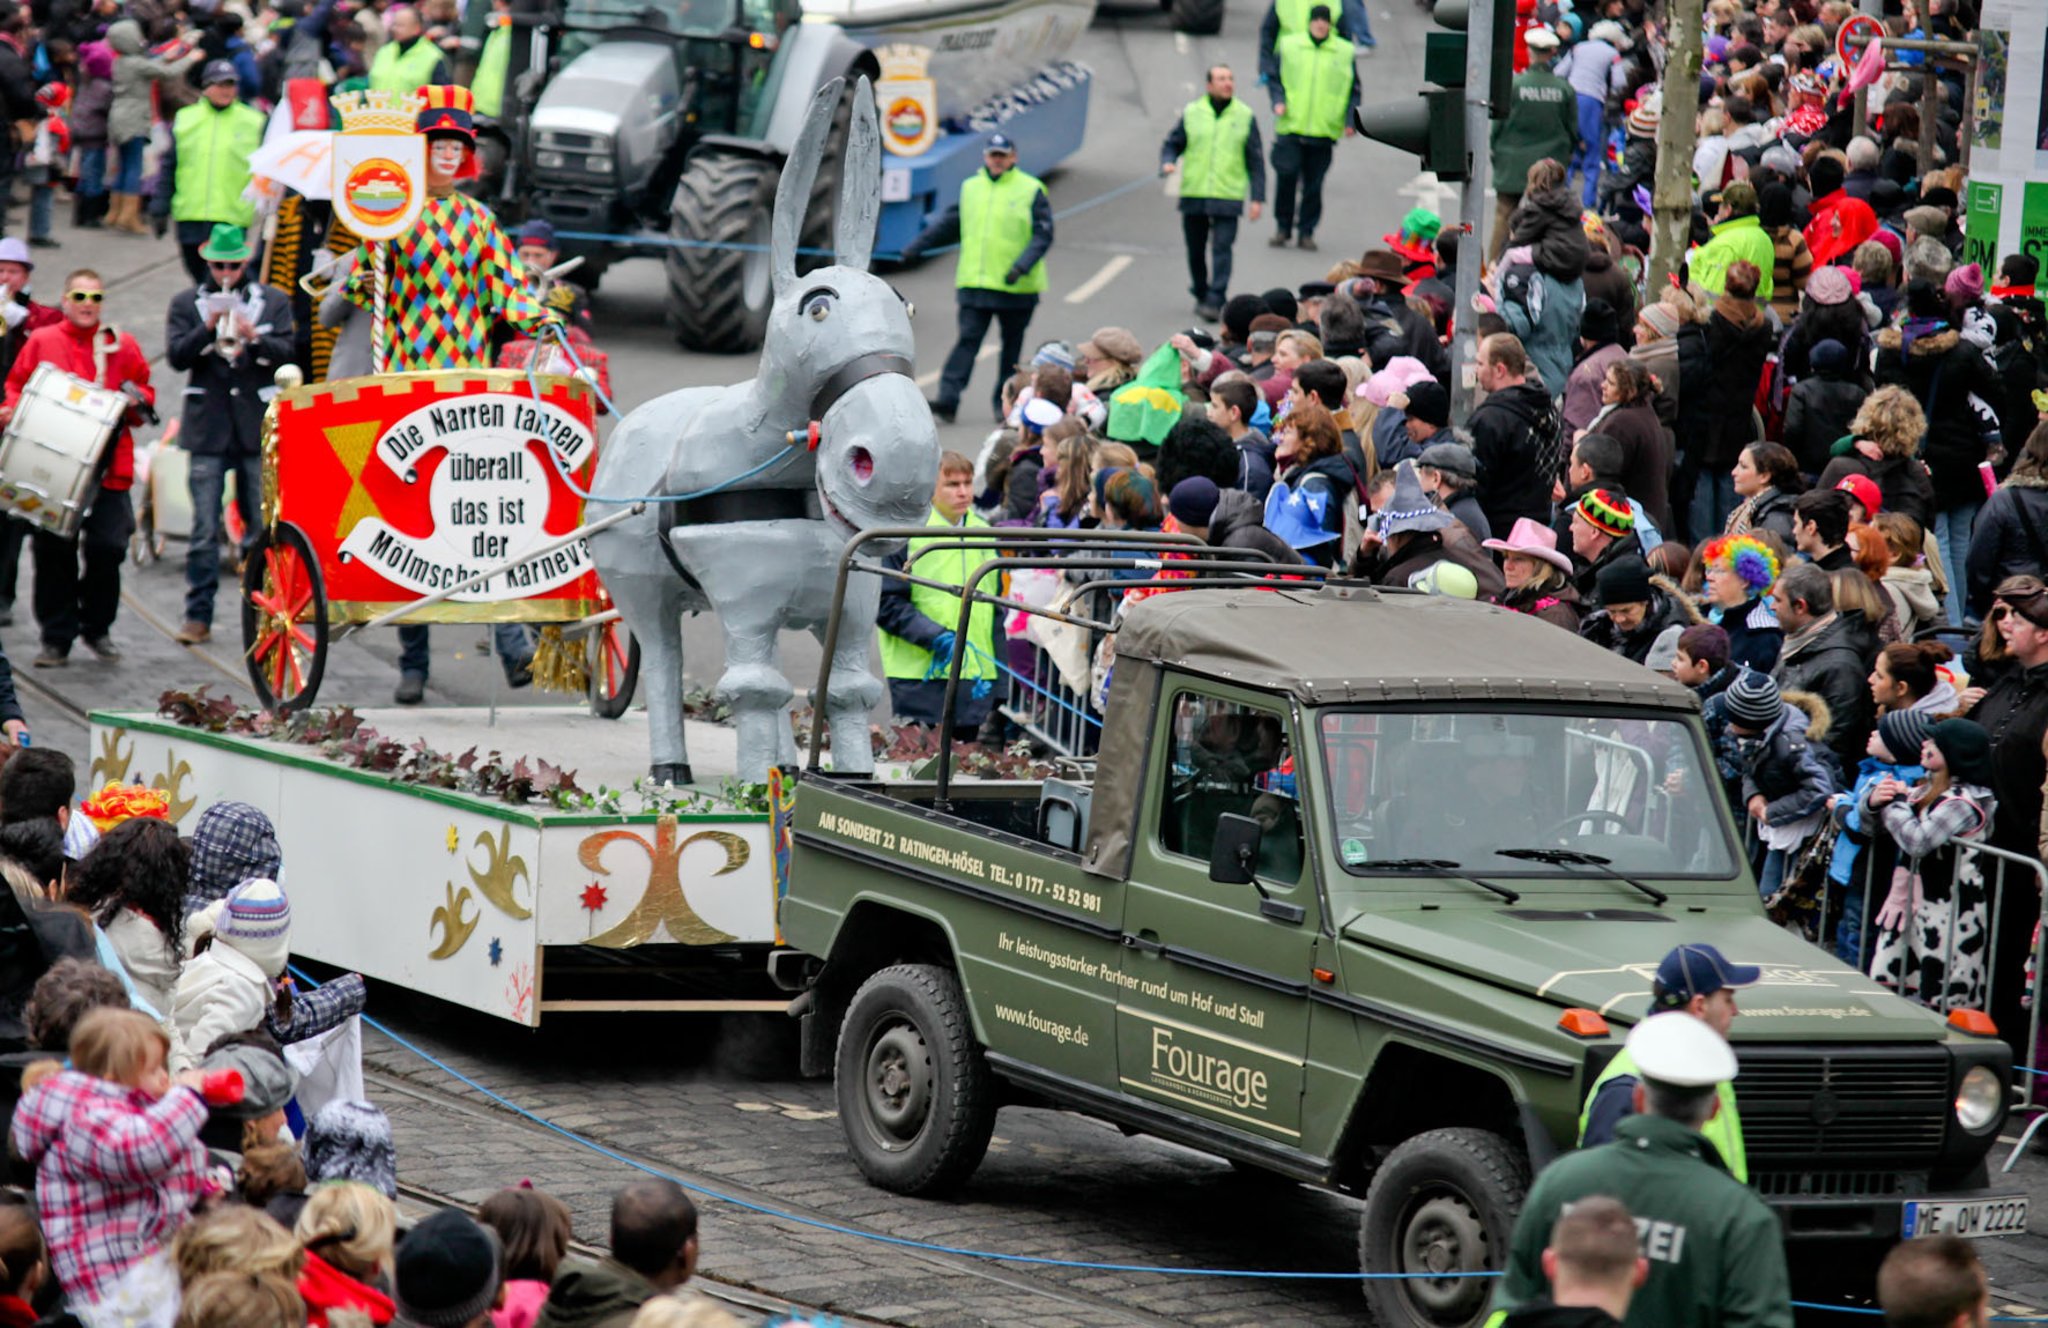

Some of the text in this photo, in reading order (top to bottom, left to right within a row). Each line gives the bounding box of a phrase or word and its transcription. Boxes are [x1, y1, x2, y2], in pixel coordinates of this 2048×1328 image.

[385, 403, 584, 461] Die Narren tanzen
[451, 497, 525, 525] das ist
[472, 531, 509, 558] der
[505, 537, 591, 589] Karneva
[818, 811, 836, 831] AM
[837, 817, 882, 845] SONDERT
[882, 831, 896, 850] 22
[899, 837, 985, 878] RATINGEN-HÖSEL
[990, 863, 1014, 886] TEL.:
[1015, 872, 1023, 889] 0
[1025, 875, 1044, 895] 177
[1052, 883, 1065, 902] 52
[1067, 888, 1080, 907] 52
[1082, 892, 1101, 913] 981
[998, 932, 1264, 1029] Ihr leistungsstarker Partner rund um Hof und Stall
[995, 1003, 1090, 1047] www.fourage.de
[1151, 1026, 1268, 1108] Fourage
[1917, 1207, 1942, 1235] ME
[1984, 1203, 2026, 1232] 2222
